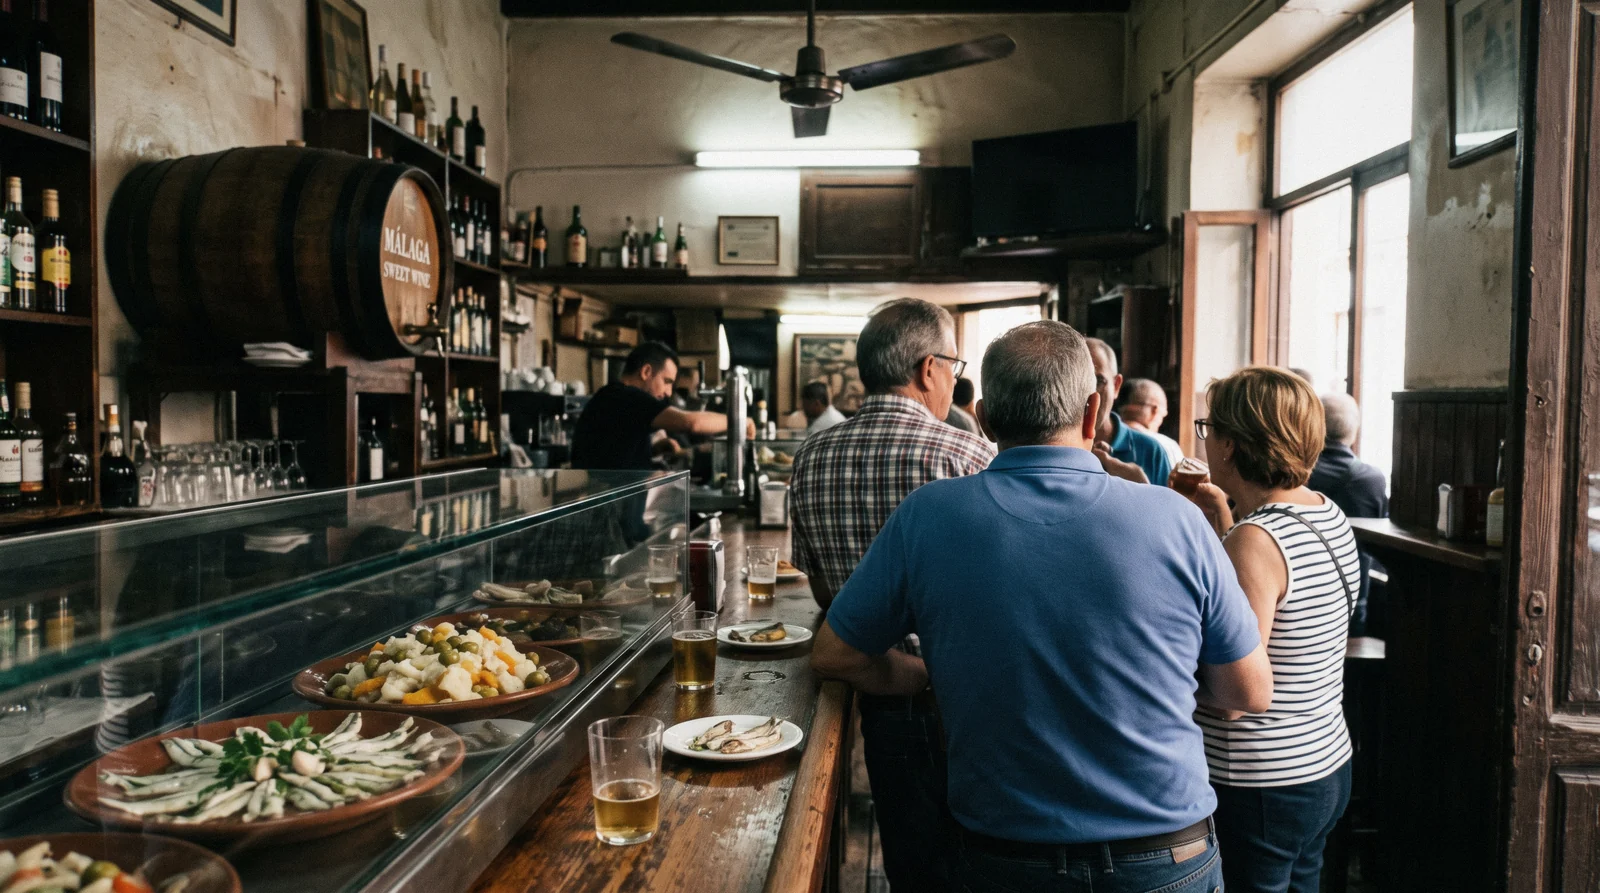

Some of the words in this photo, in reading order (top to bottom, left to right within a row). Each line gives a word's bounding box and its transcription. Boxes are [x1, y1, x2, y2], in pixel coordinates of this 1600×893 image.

[384, 225, 431, 265] MÁLAGA
[383, 261, 410, 283] SWEET
[411, 268, 431, 289] WINE
